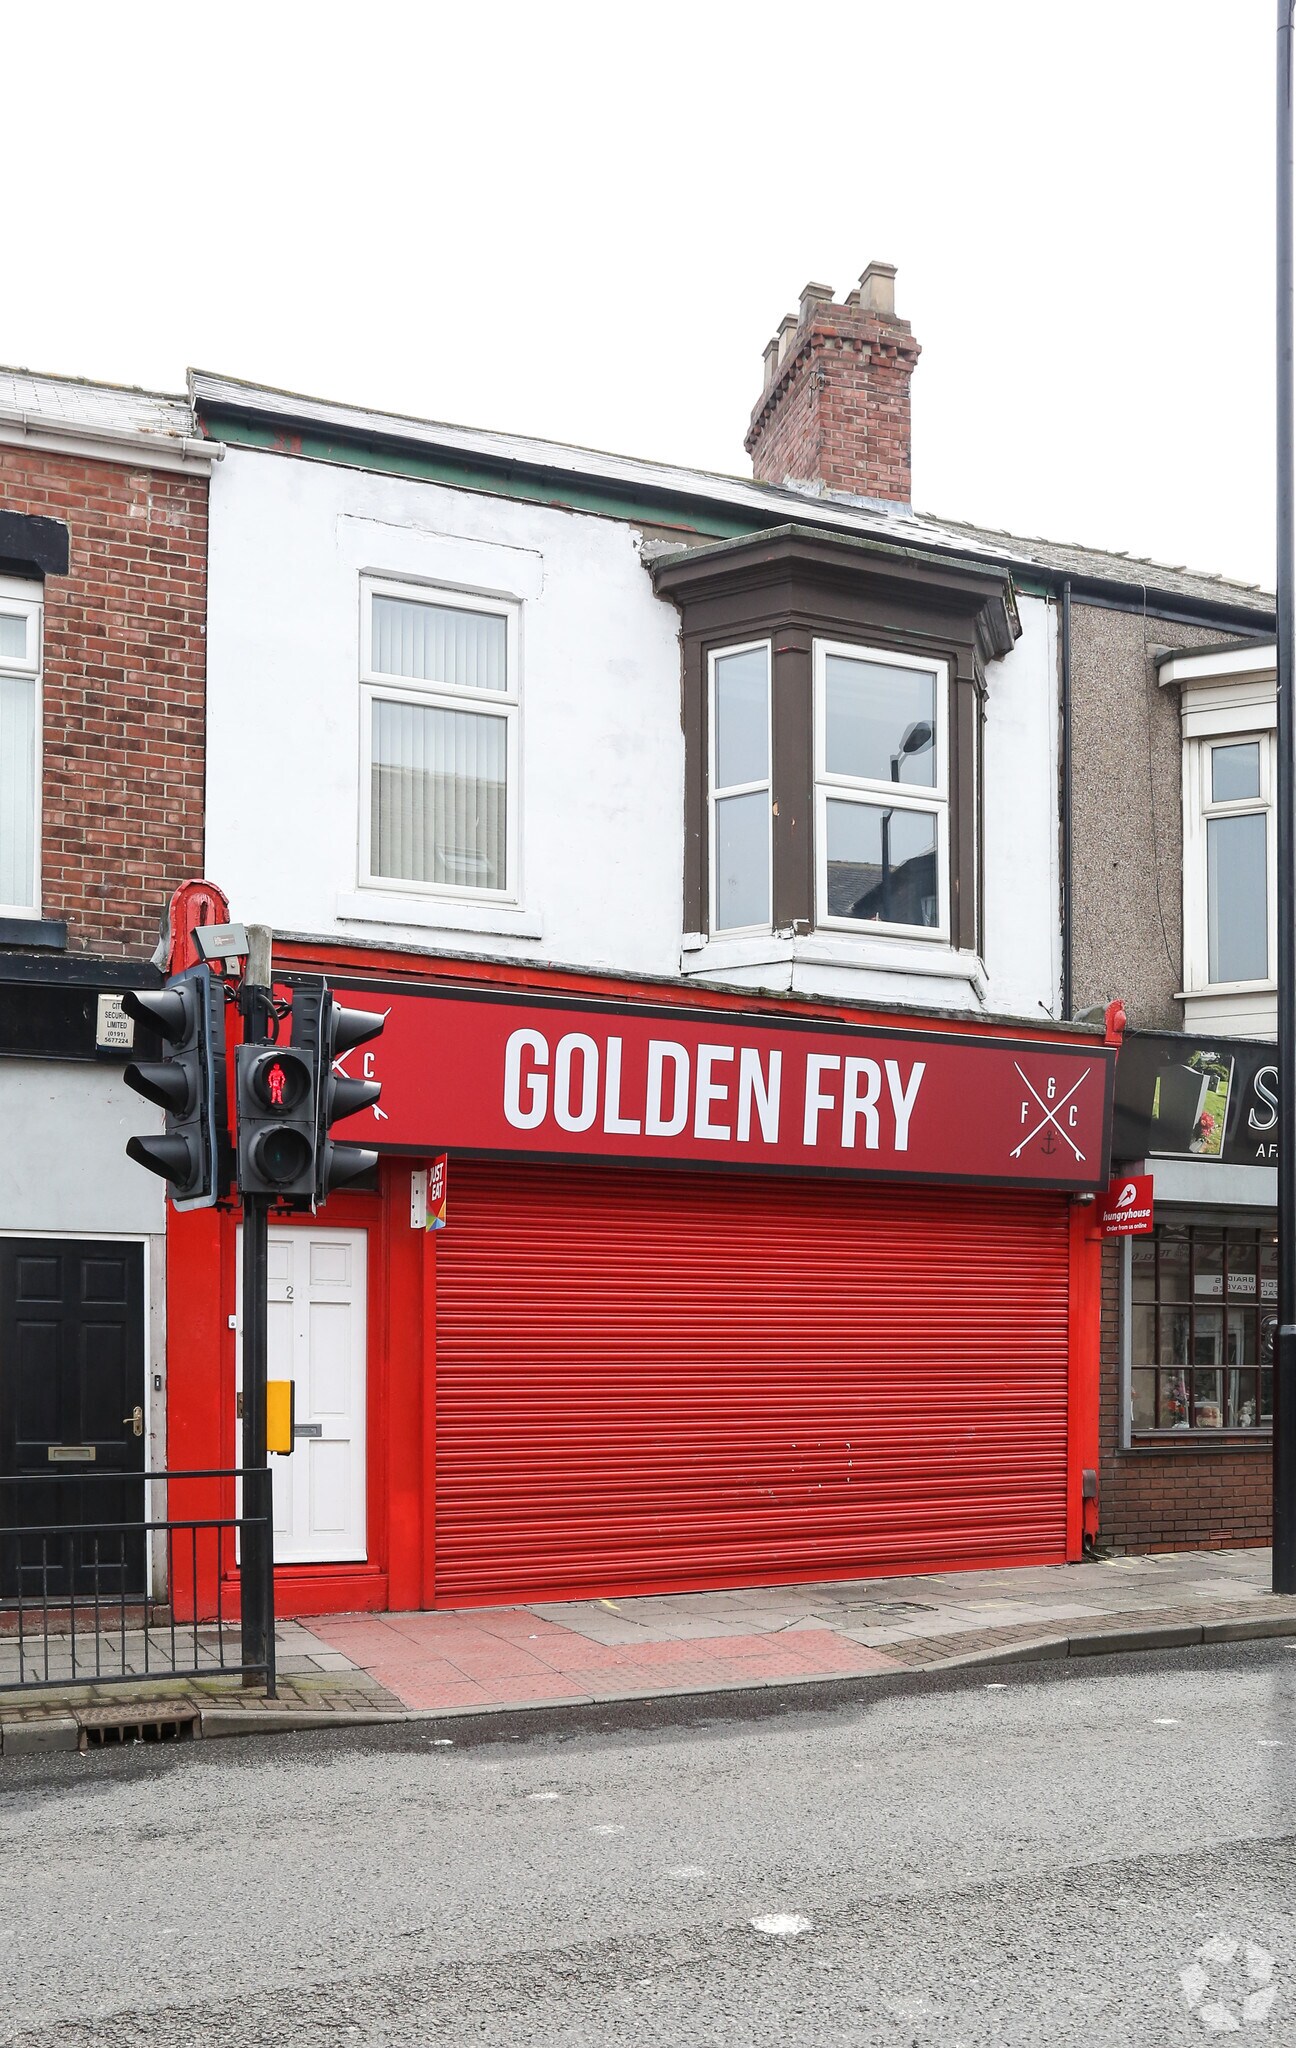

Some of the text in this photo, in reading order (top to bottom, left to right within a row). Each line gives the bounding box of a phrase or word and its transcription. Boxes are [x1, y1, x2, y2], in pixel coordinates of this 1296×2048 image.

[112, 1002, 123, 1010] CIT
[106, 1021, 128, 1029] LIMITED
[363, 1052, 376, 1079] C
[503, 1028, 927, 1151] GOLDEN FRY
[1047, 1077, 1056, 1099] &
[1021, 1101, 1078, 1127] F C
[1255, 1143, 1279, 1158] AF
[429, 1162, 444, 1187] JUST
[431, 1181, 444, 1201] EAT
[1103, 1208, 1151, 1222] hungryhouse
[286, 1285, 294, 1300] 2
